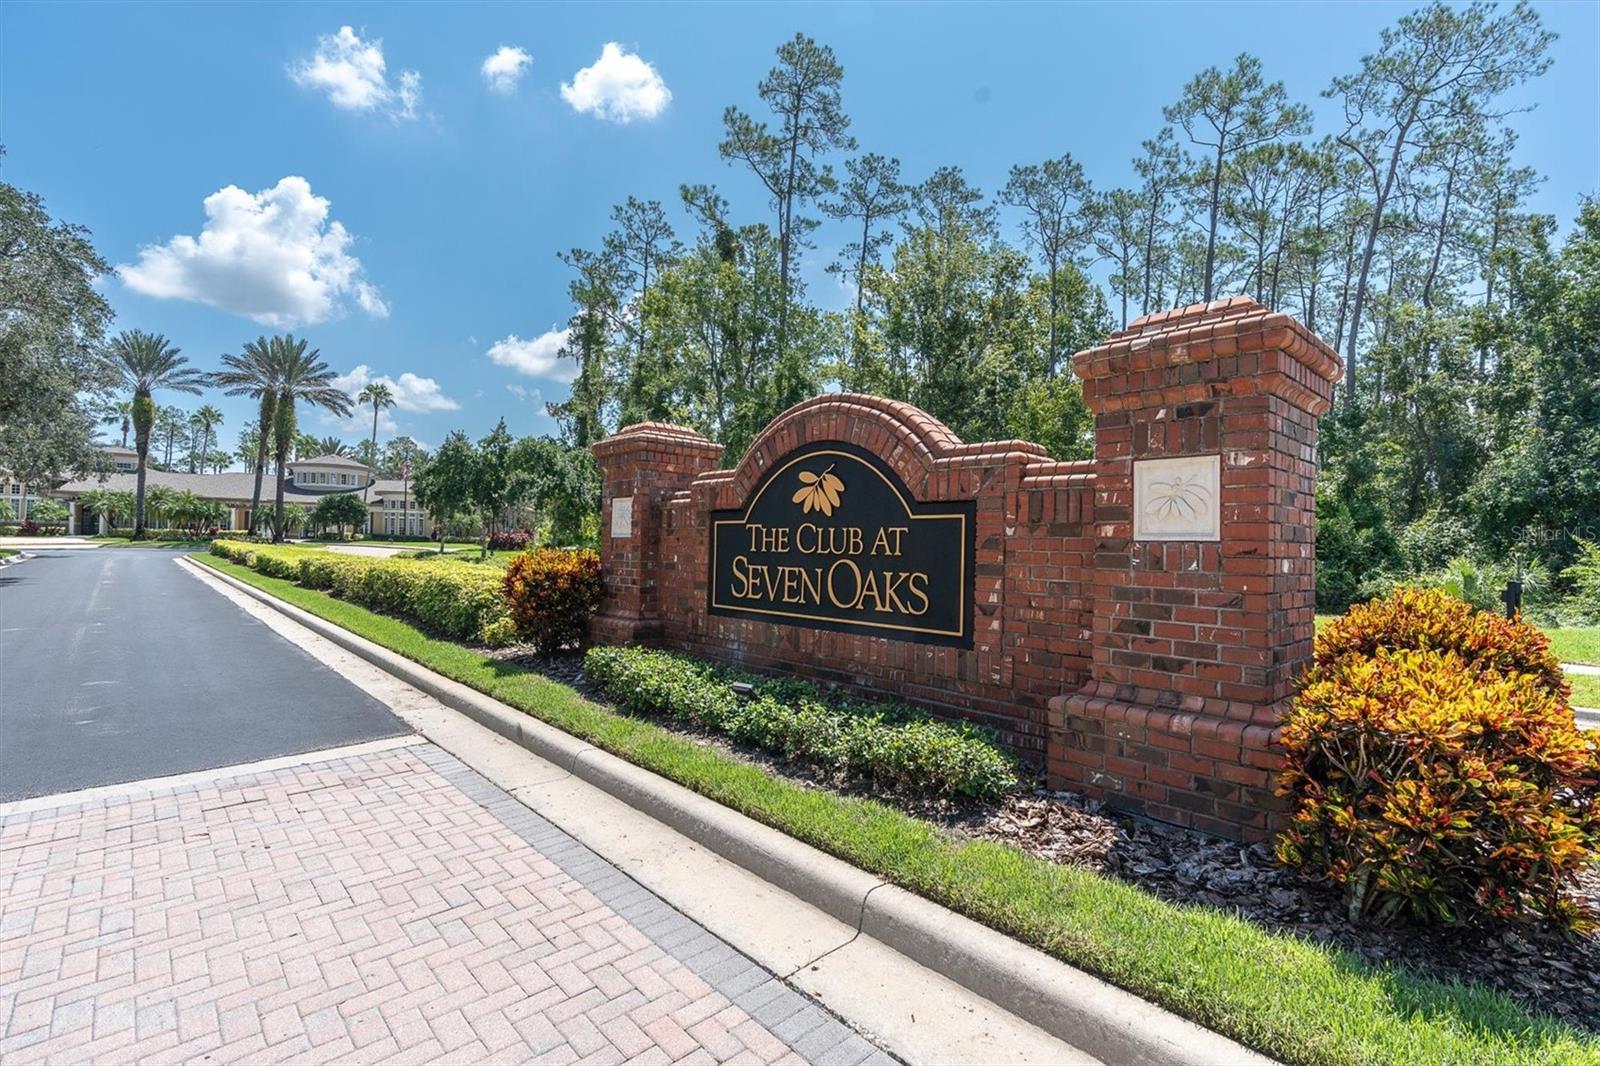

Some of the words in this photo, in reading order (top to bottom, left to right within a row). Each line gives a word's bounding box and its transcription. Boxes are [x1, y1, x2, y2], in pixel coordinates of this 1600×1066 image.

[746, 523, 790, 553] THE
[796, 522, 864, 556] CLUB
[870, 527, 909, 556] AT
[731, 555, 823, 606] SEVEN
[827, 558, 929, 616] OAKS
